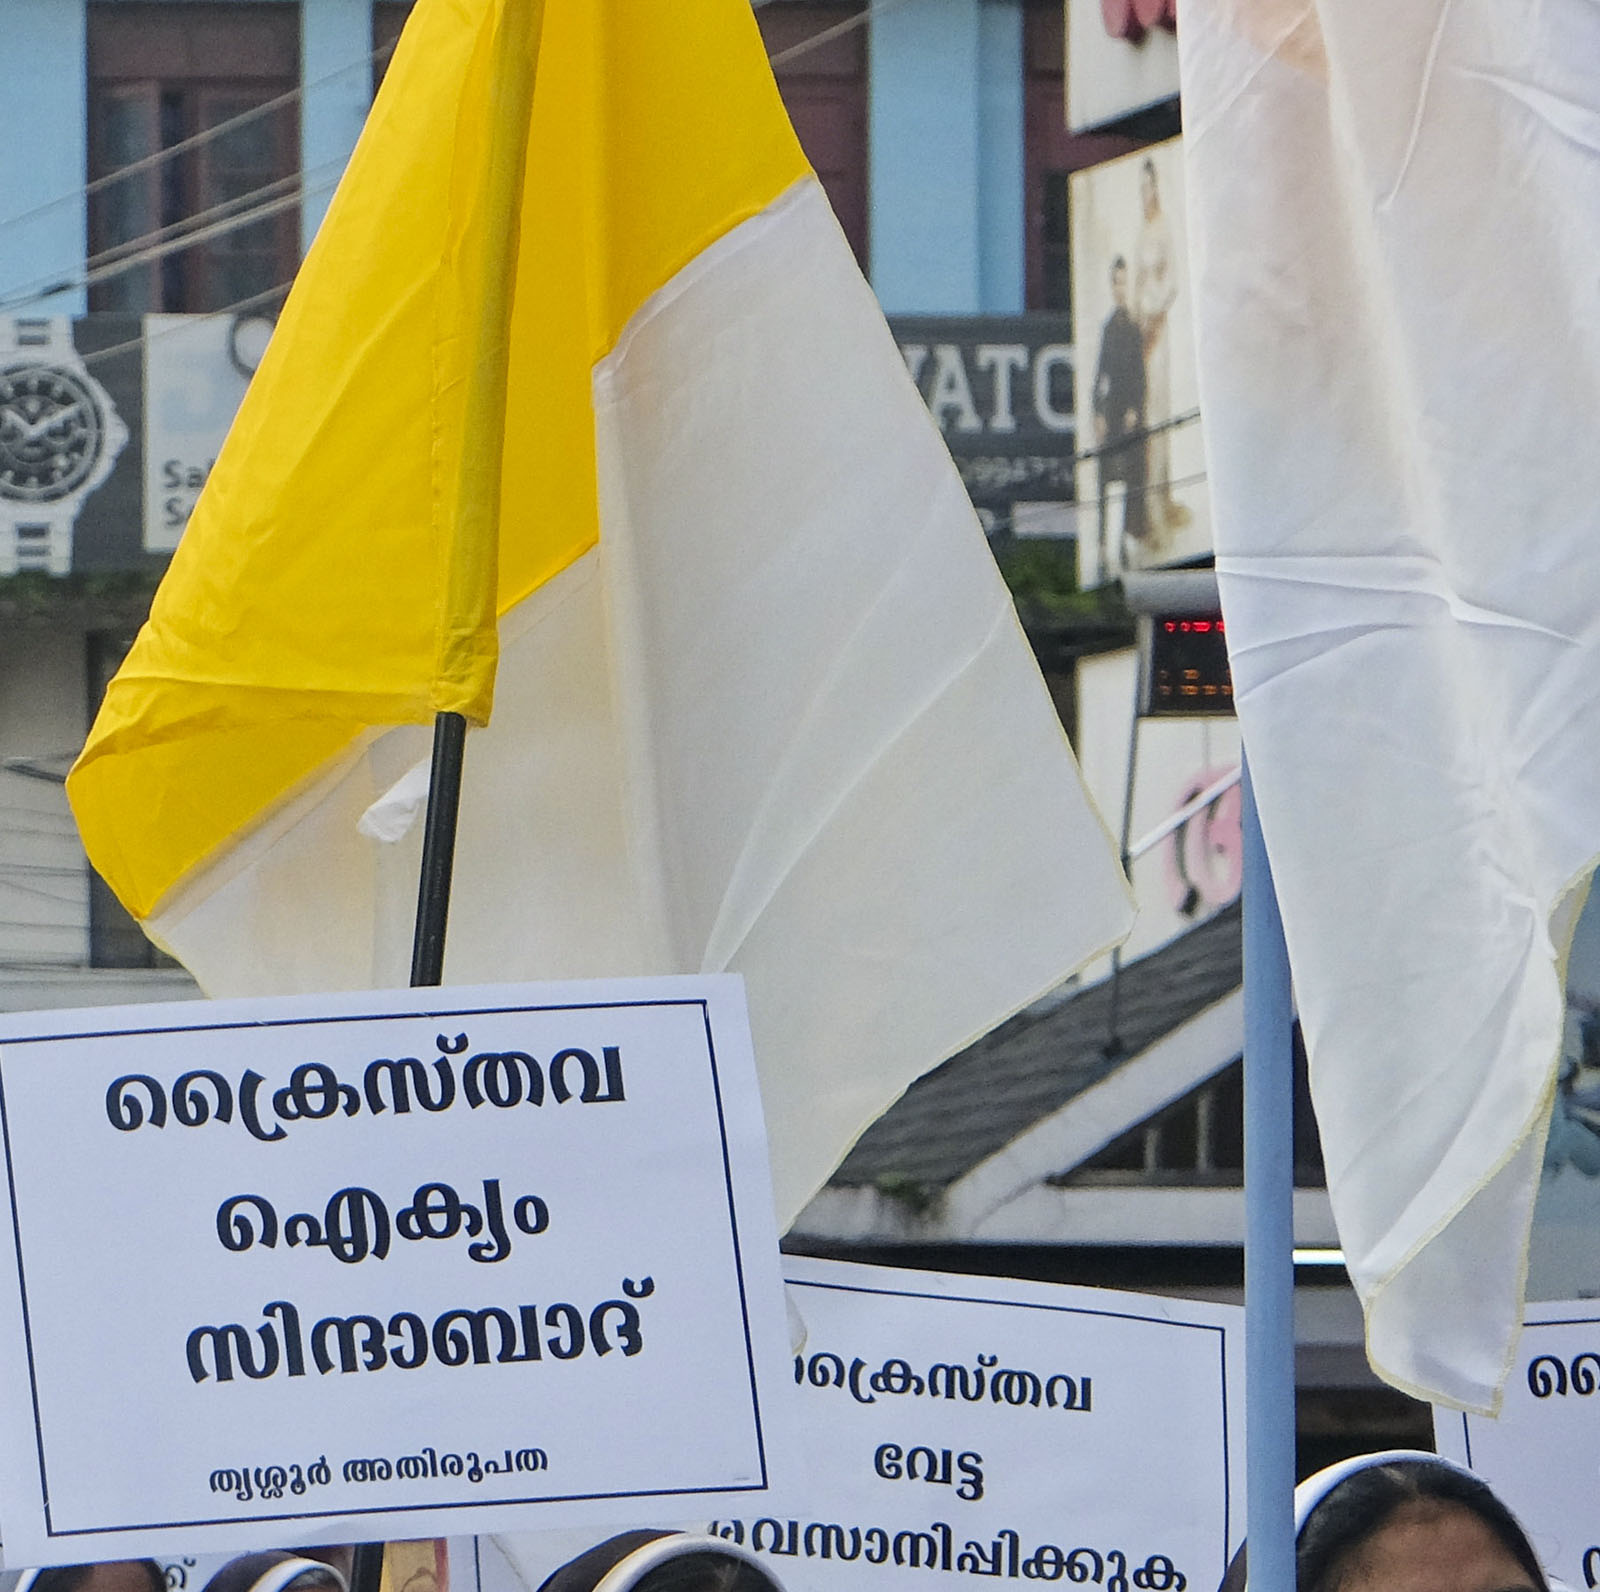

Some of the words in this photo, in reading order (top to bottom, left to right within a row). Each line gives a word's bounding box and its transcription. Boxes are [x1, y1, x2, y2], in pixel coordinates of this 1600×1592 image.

[106, 1033, 626, 1142] ക്രൈസ്തവ
[216, 1179, 550, 1264] ഐക്യം
[186, 1277, 655, 1384] സിന്ദാബാദ്
[342, 1448, 549, 1483] അതിരൂപത
[874, 1444, 985, 1500] വേട്ട
